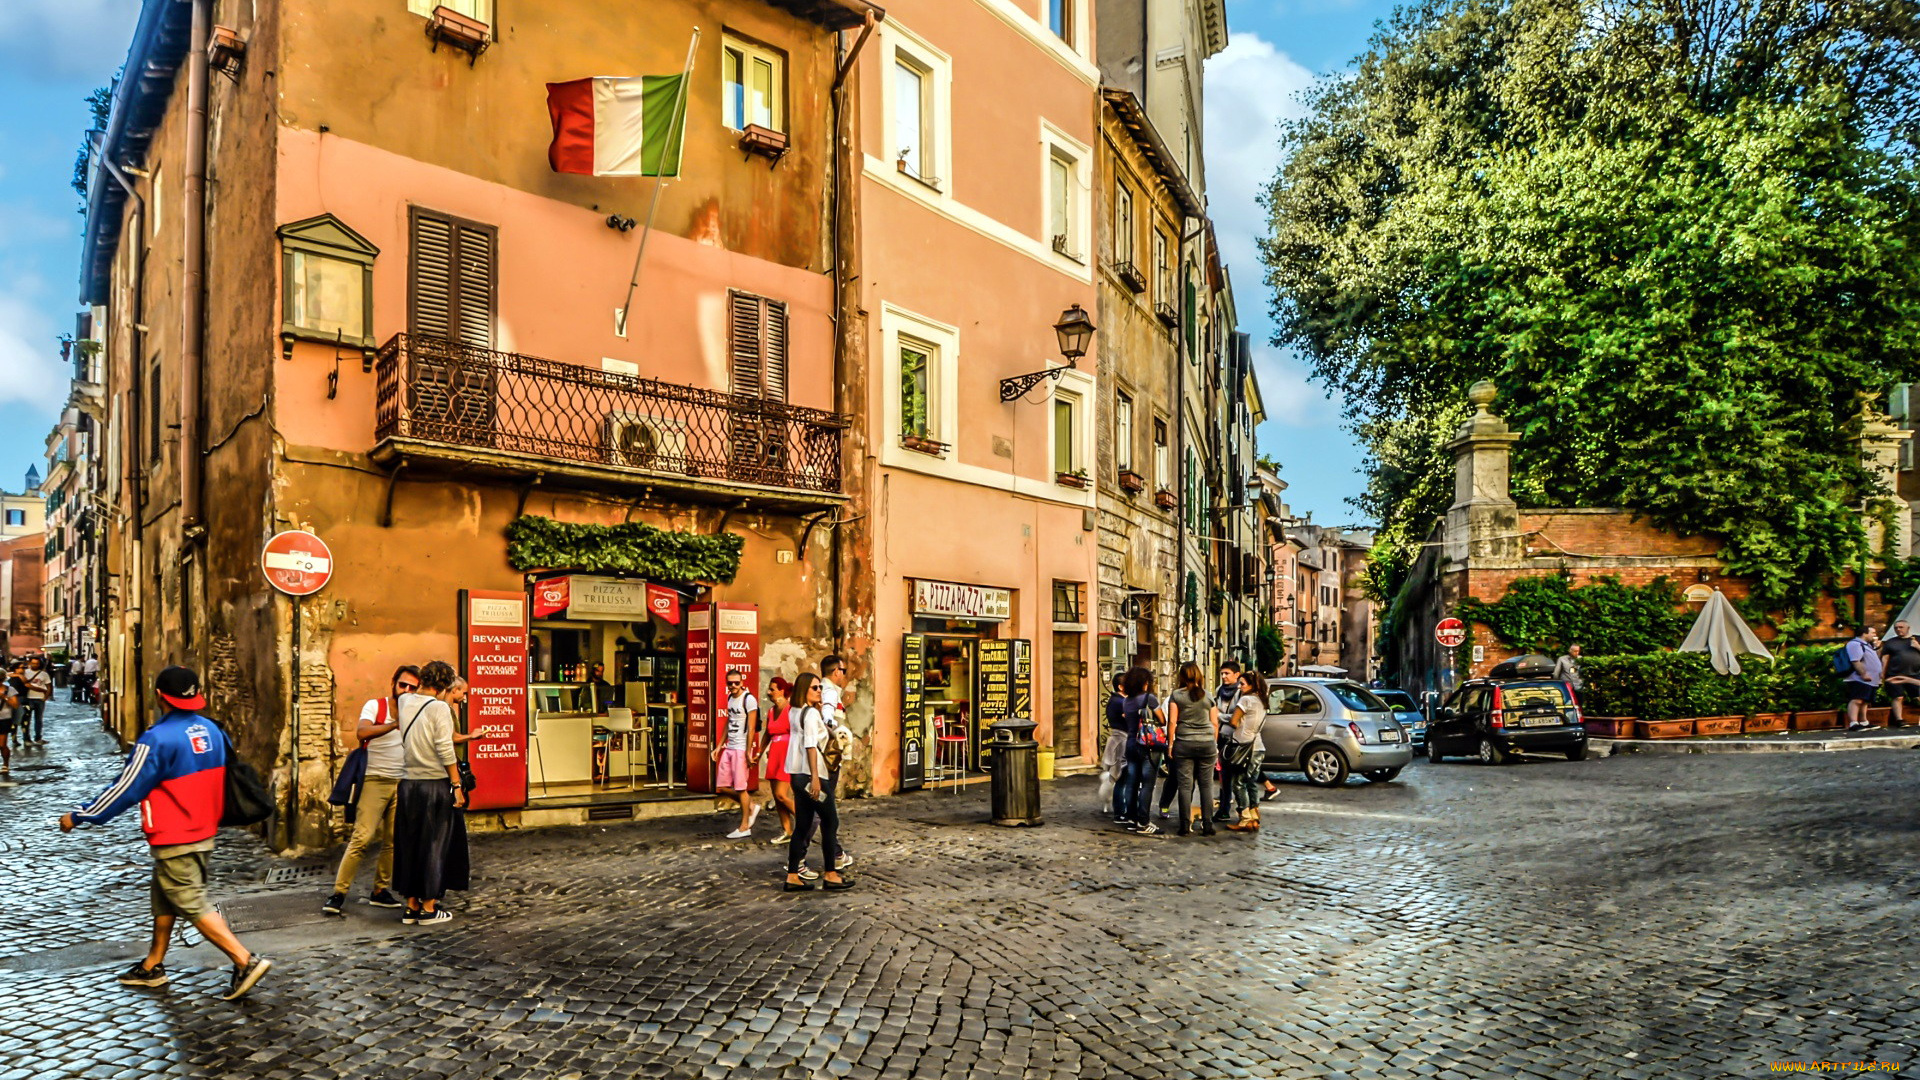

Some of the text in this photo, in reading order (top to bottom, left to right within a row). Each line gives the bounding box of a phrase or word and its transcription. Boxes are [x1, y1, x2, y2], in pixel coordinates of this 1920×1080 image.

[593, 586, 623, 594] PIZZA
[584, 594, 632, 605] TRILUSSA
[472, 635, 523, 644] BEVANDE
[726, 641, 750, 650] PIZZA
